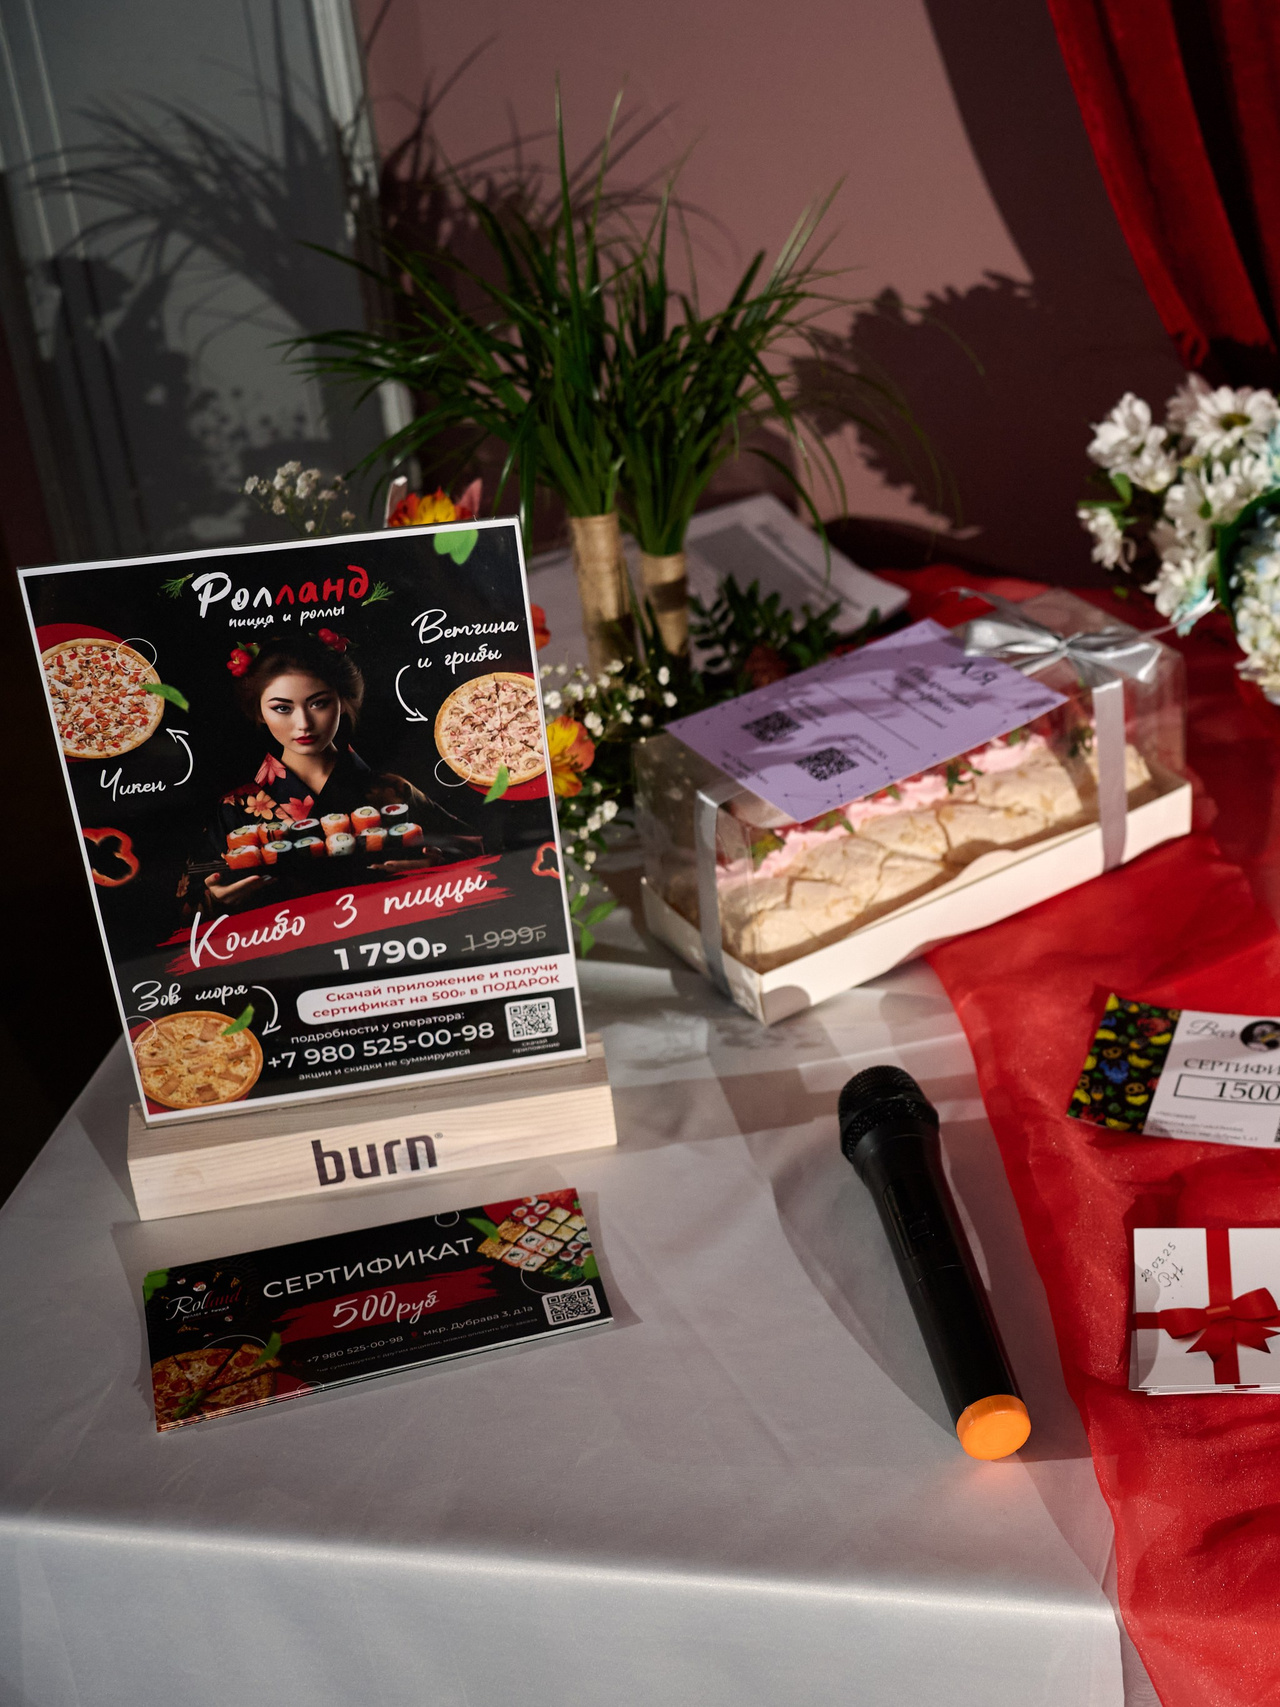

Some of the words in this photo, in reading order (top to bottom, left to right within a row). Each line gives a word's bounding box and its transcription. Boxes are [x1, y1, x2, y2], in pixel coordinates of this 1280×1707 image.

[191, 564, 369, 618] Ролланд
[228, 614, 274, 629] пицца
[282, 613, 292, 622] и
[300, 606, 345, 626] роллы
[410, 608, 519, 645] Ветчина
[417, 657, 432, 669] и
[444, 643, 502, 674] грибы
[100, 768, 166, 801] Чикен
[189, 909, 306, 968] Комбо
[333, 893, 358, 929] 3
[383, 873, 487, 914] пиццы
[131, 980, 182, 1012] Зов
[195, 984, 249, 1006] моря
[312, 998, 406, 1018] сертификат
[410, 994, 428, 1003] на
[470, 987, 479, 996] в
[483, 975, 560, 994] ПОДАРОК
[326, 986, 382, 1002] Скачай
[387, 972, 485, 994] приложение
[489, 971, 499, 980] и
[503, 963, 558, 977] получи
[268, 1051, 297, 1069] +7
[304, 1043, 355, 1066] 980
[363, 1021, 495, 1057] 525-00-98
[291, 1022, 379, 1044] подробности
[382, 1024, 390, 1033] у
[392, 1012, 465, 1029] оператора:
[298, 1070, 332, 1081] акции
[334, 1068, 342, 1076] и
[344, 1063, 382, 1074] скидки
[385, 1059, 398, 1068] не
[400, 1048, 471, 1066] суммируются
[262, 1237, 474, 1298] СЕРТИФИКАТ
[332, 1290, 440, 1329] 500руб
[423, 1326, 449, 1337] мкр.
[451, 1313, 500, 1331] Дубрава
[322, 1350, 344, 1360] 980
[346, 1335, 404, 1355] 525-00-98
